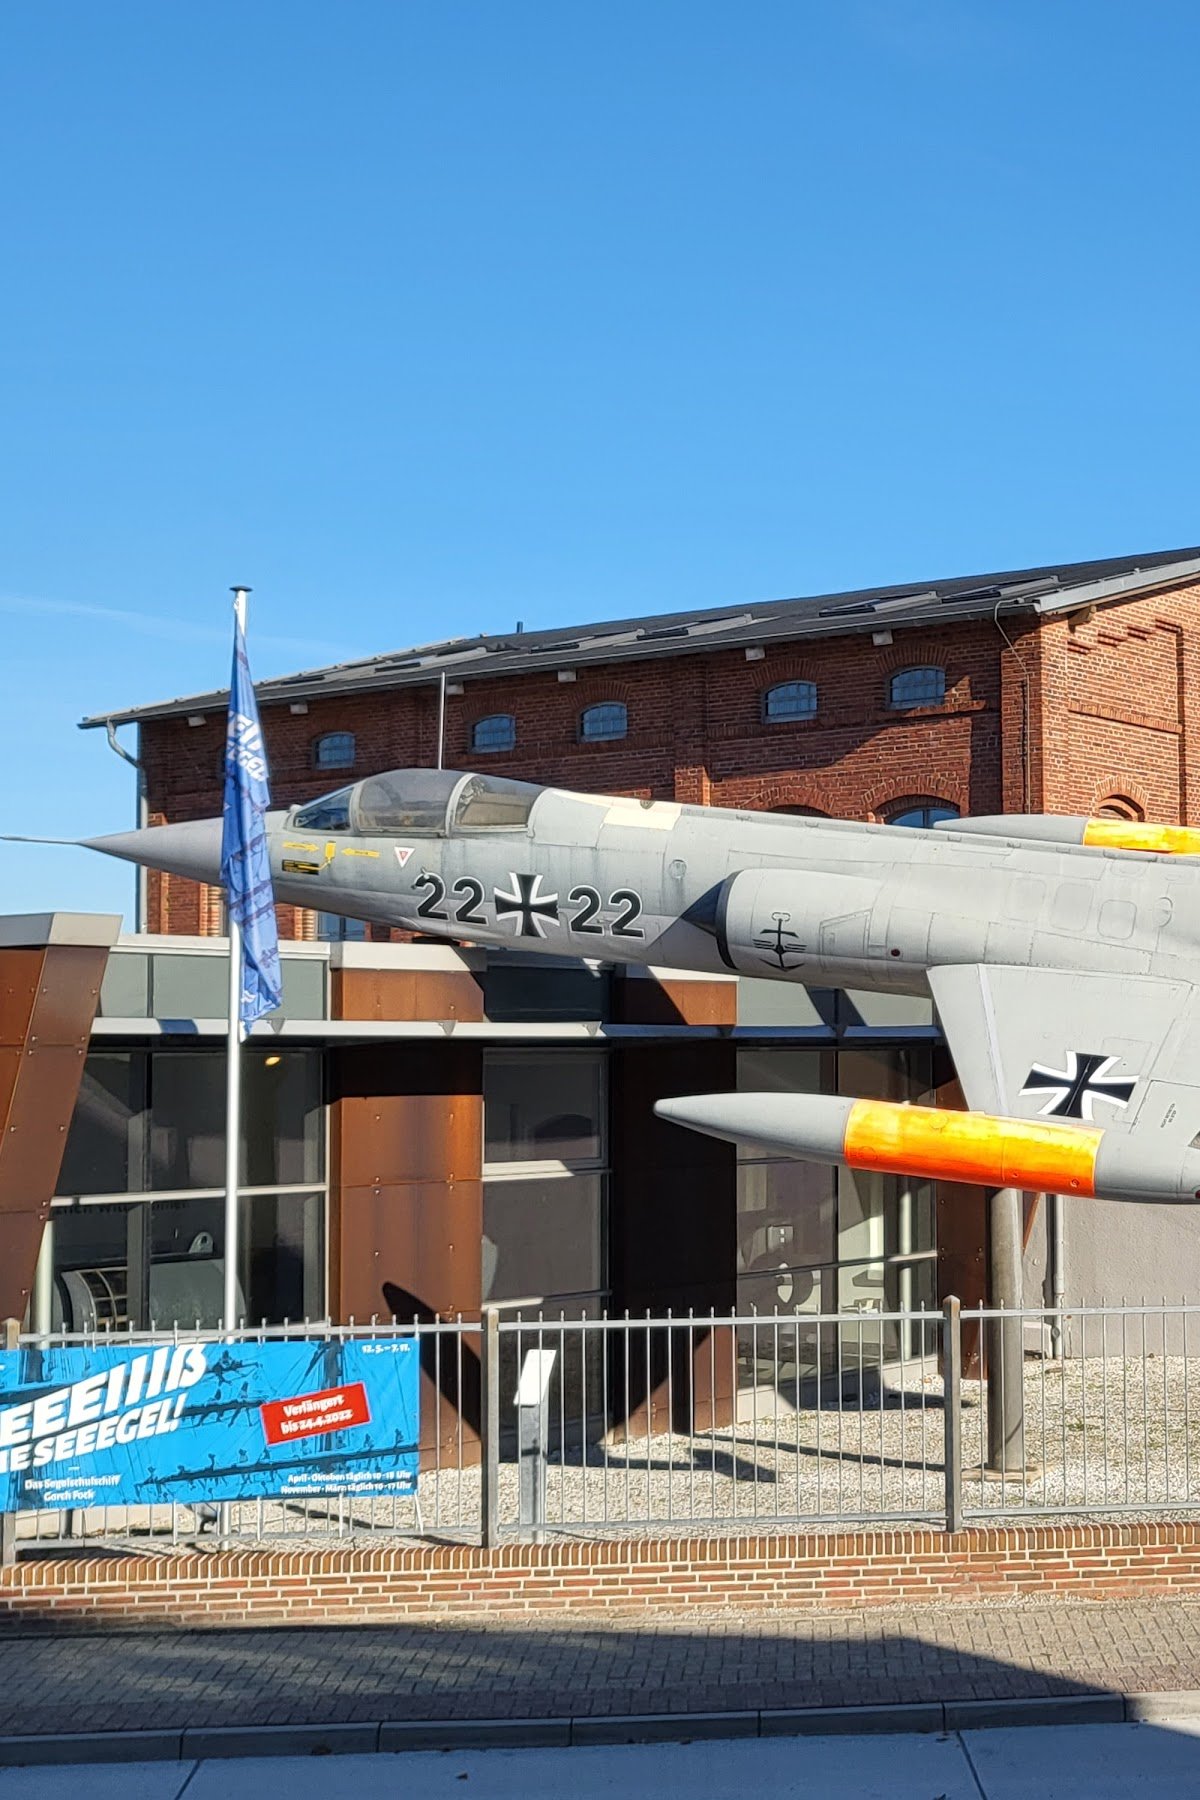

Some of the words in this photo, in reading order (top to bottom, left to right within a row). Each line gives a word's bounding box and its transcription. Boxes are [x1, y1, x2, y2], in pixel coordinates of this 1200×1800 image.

[413, 872, 489, 925] 22
[567, 884, 645, 939] 22
[283, 1394, 344, 1418] Verlängert
[280, 1420, 300, 1435] bis
[288, 1473, 307, 1484] April
[396, 1469, 412, 1479] Uhr
[24, 1479, 43, 1490] Das
[281, 1483, 321, 1494] November
[396, 1481, 412, 1490] Uhr
[73, 1488, 95, 1500] Fock
